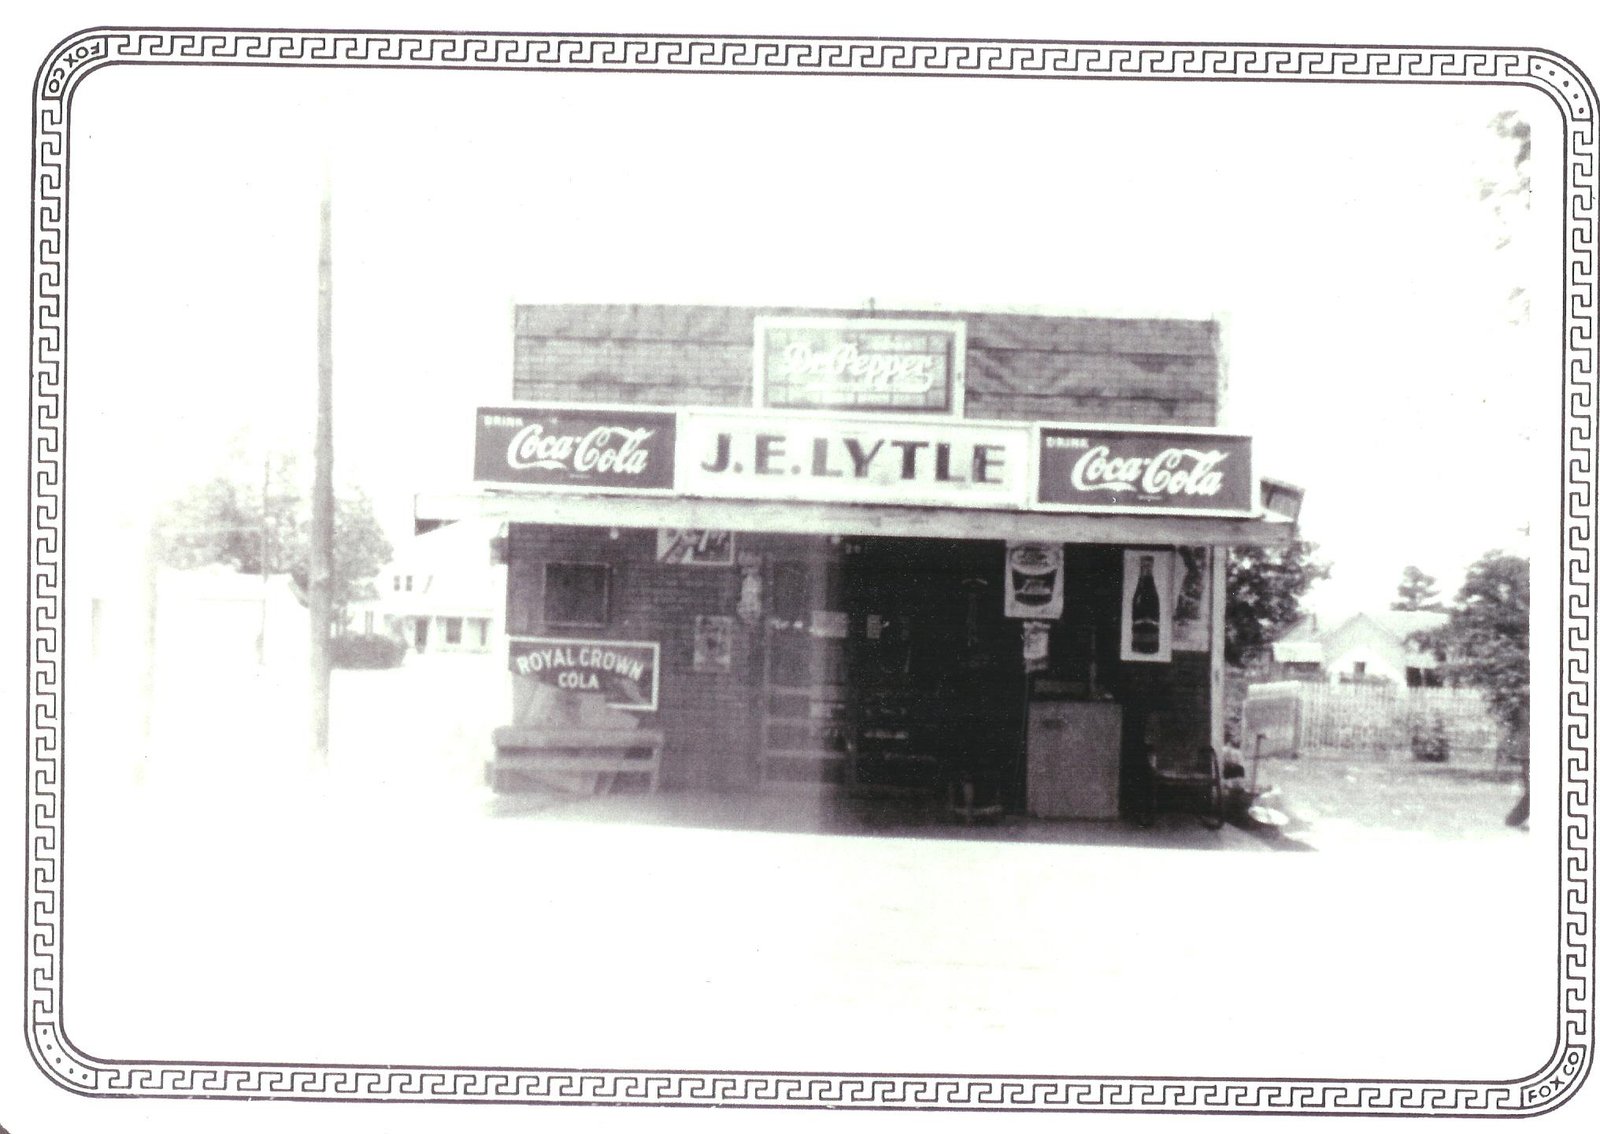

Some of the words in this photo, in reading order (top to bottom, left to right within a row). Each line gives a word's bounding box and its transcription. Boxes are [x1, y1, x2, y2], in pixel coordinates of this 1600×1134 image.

[515, 647, 576, 676] ROYAL
[579, 647, 645, 682] CROWN
[557, 672, 600, 690] COLA
